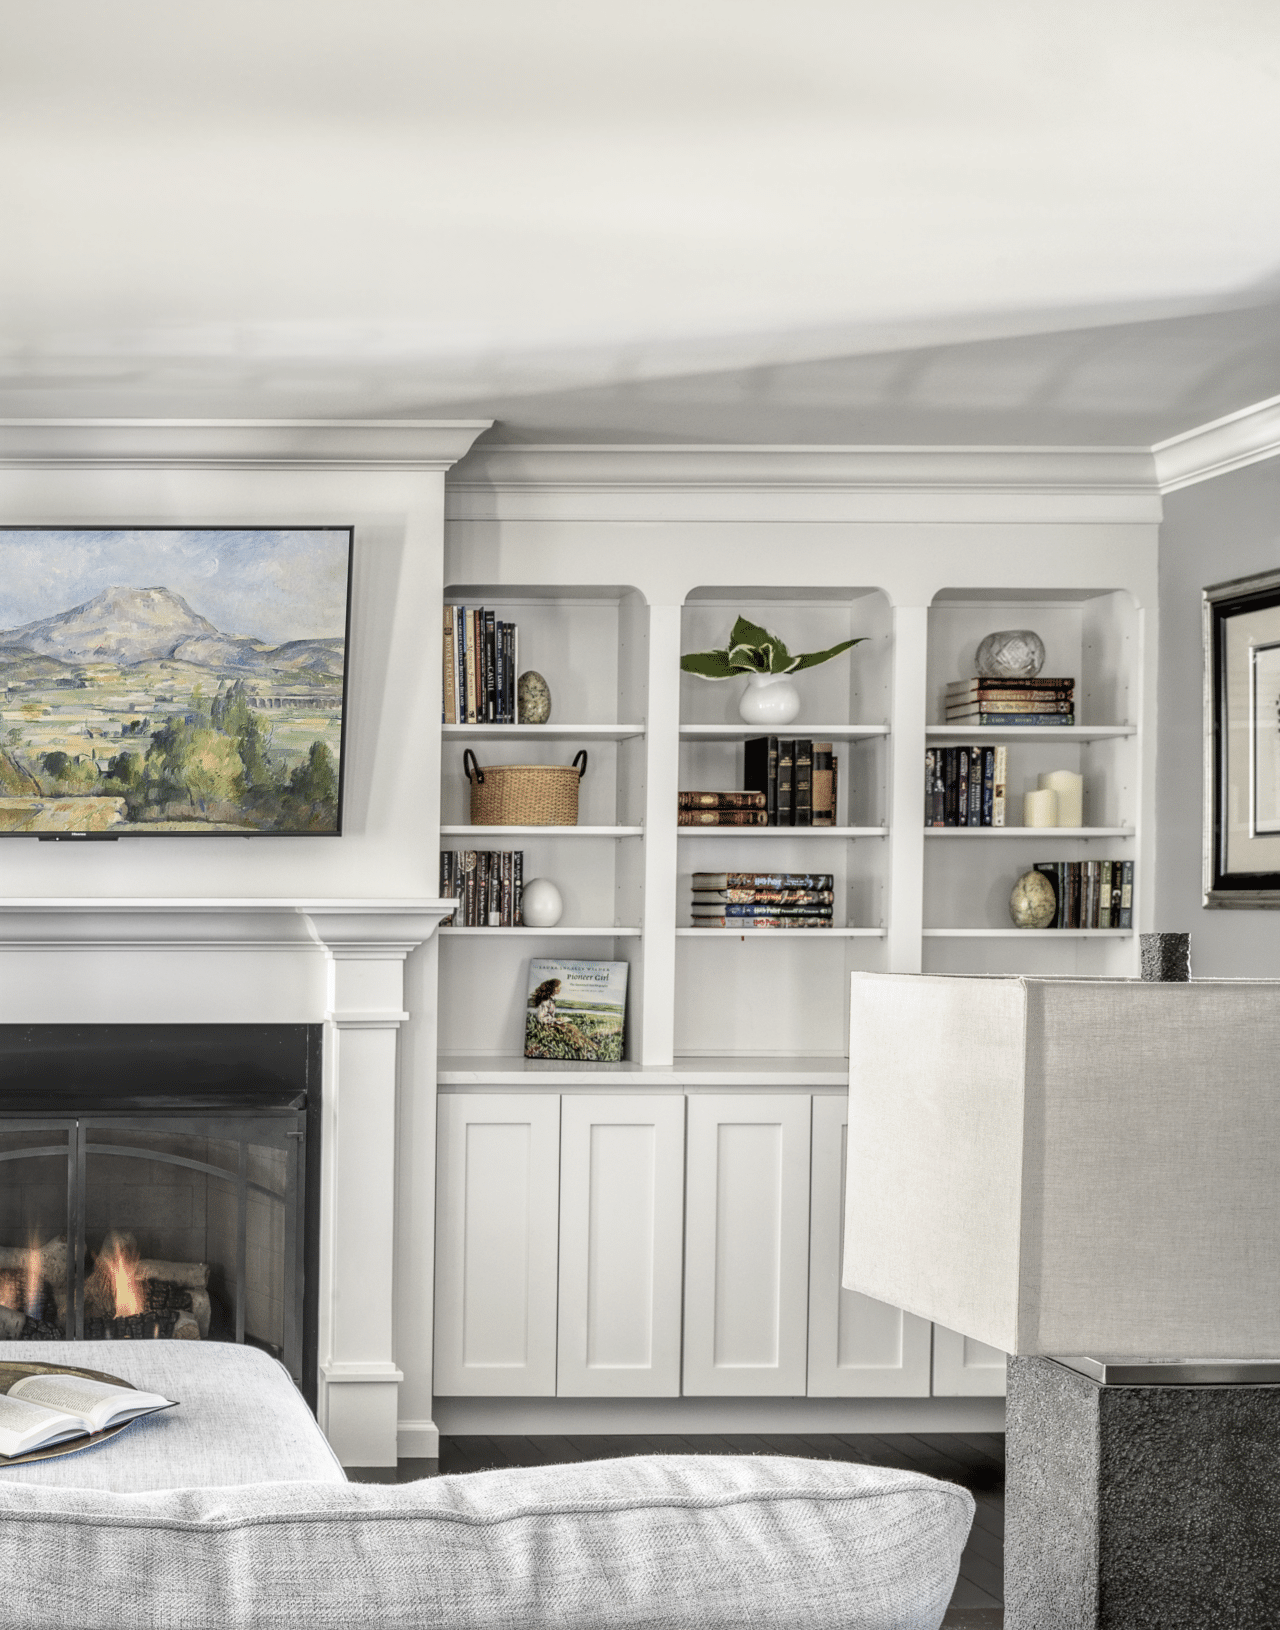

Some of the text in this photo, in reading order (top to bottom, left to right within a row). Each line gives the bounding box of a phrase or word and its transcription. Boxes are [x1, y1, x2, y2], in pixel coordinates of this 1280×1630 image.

[445, 636, 454, 696] ROYAL PALACES
[487, 666, 495, 692] CASTLE
[754, 877, 782, 886] Harry Potter
[566, 973, 610, 982] Pioneer Girl
